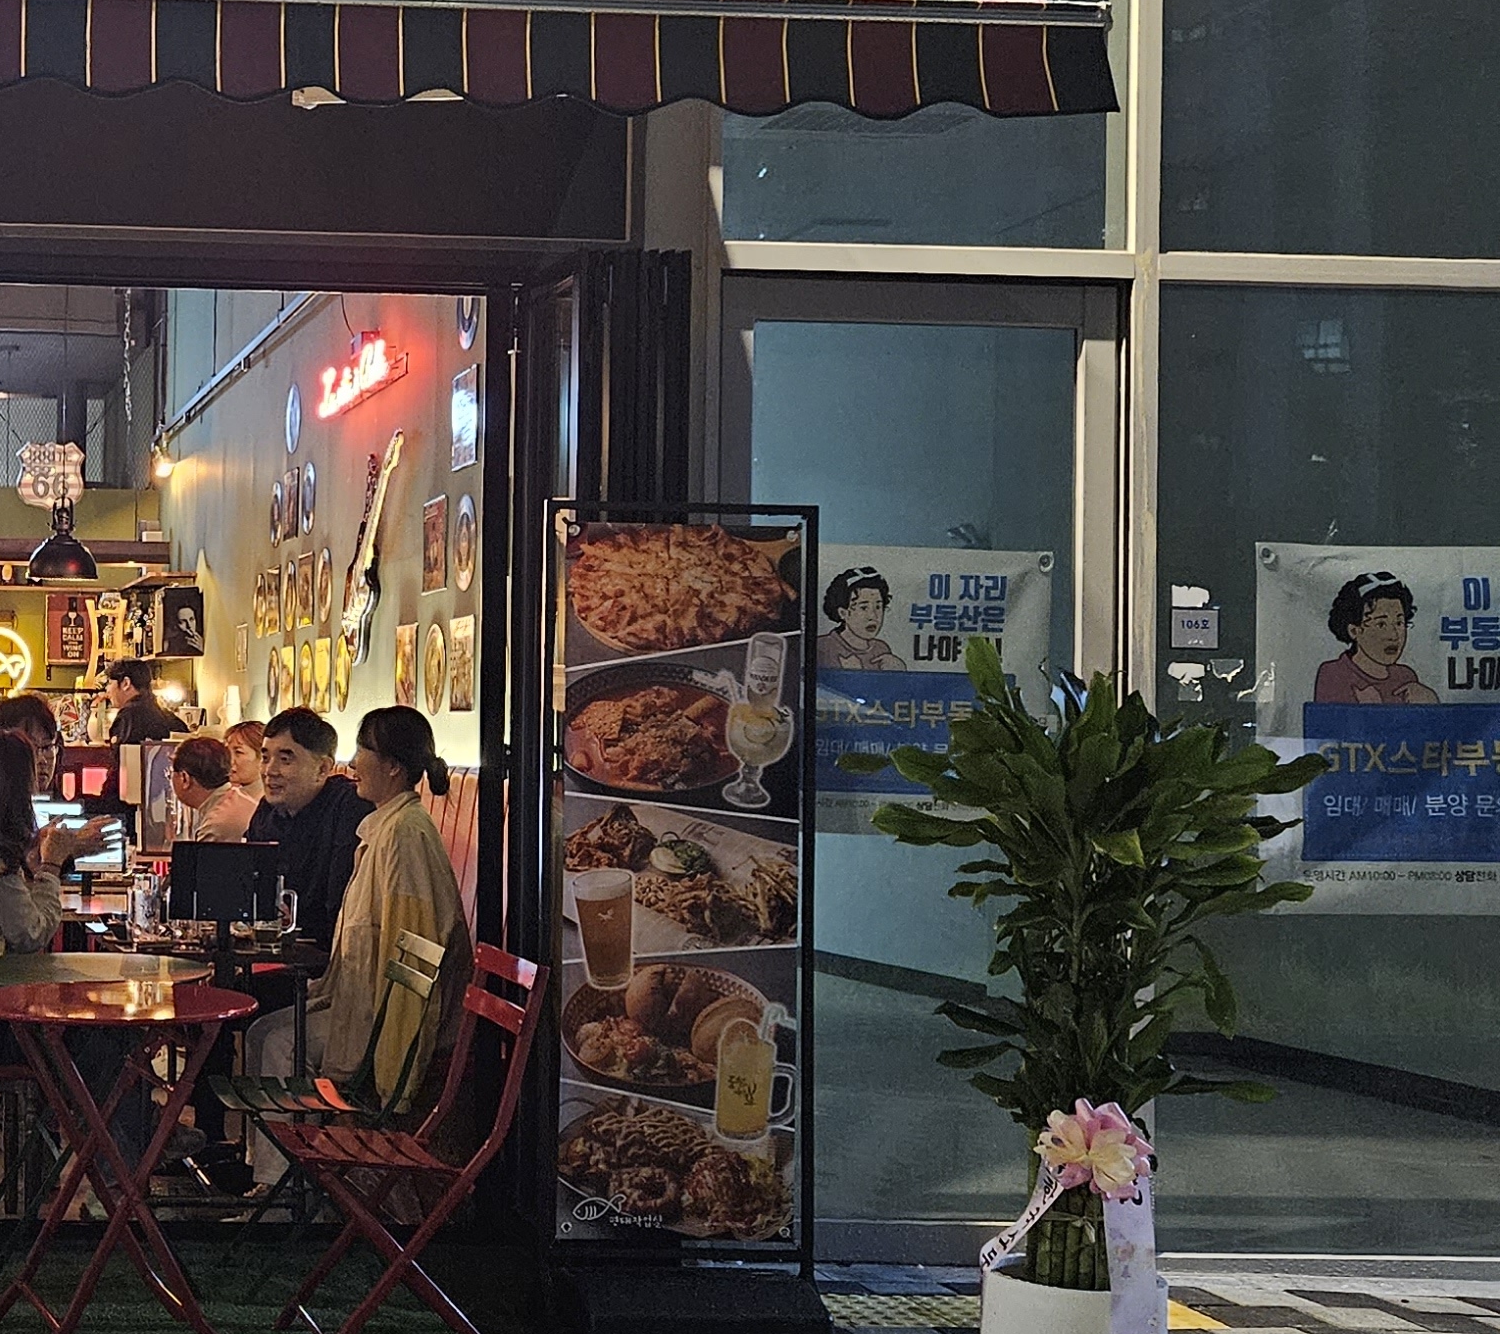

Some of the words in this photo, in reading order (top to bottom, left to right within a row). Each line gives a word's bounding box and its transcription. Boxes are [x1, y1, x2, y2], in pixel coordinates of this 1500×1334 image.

[31, 472, 70, 499] 66
[929, 573, 951, 601] 이
[959, 574, 1007, 602] 자리
[1463, 577, 1491, 611] 이
[909, 602, 1005, 633] 부동산은
[1181, 618, 1210, 630] 106호
[913, 634, 962, 663] 나야
[1319, 738, 1500, 778] GTX스타부
[1425, 793, 1469, 817] 분양
[1475, 794, 1500, 817] 문
